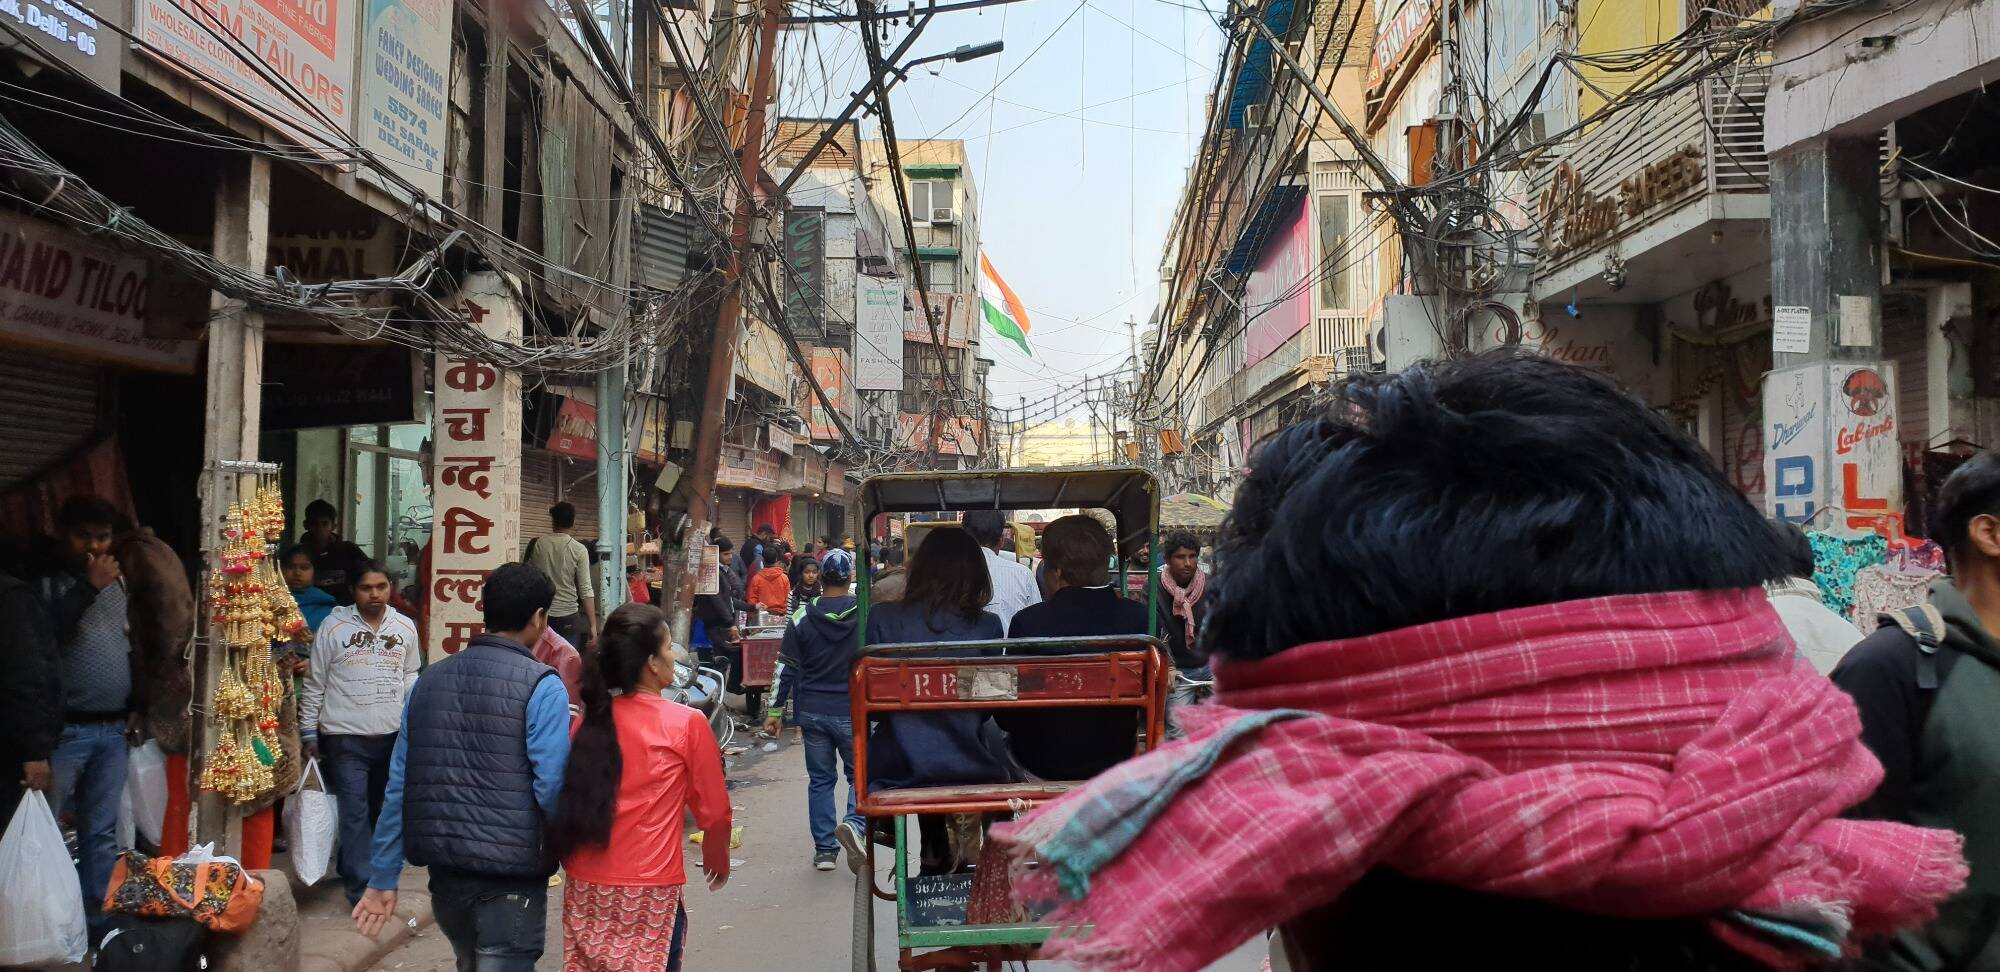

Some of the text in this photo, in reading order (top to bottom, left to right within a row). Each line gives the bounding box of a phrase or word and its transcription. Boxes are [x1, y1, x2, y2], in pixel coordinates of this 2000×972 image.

[149, 2, 206, 50] WHOLESALE
[207, 41, 235, 69] CLOTH
[378, 26, 403, 65] FANCY
[251, 24, 344, 118] TAILORS
[373, 107, 439, 162] NAI SARAK
[387, 95, 429, 136] 5574
[377, 126, 416, 161] DELHI
[860, 357, 901, 365] FASHION
